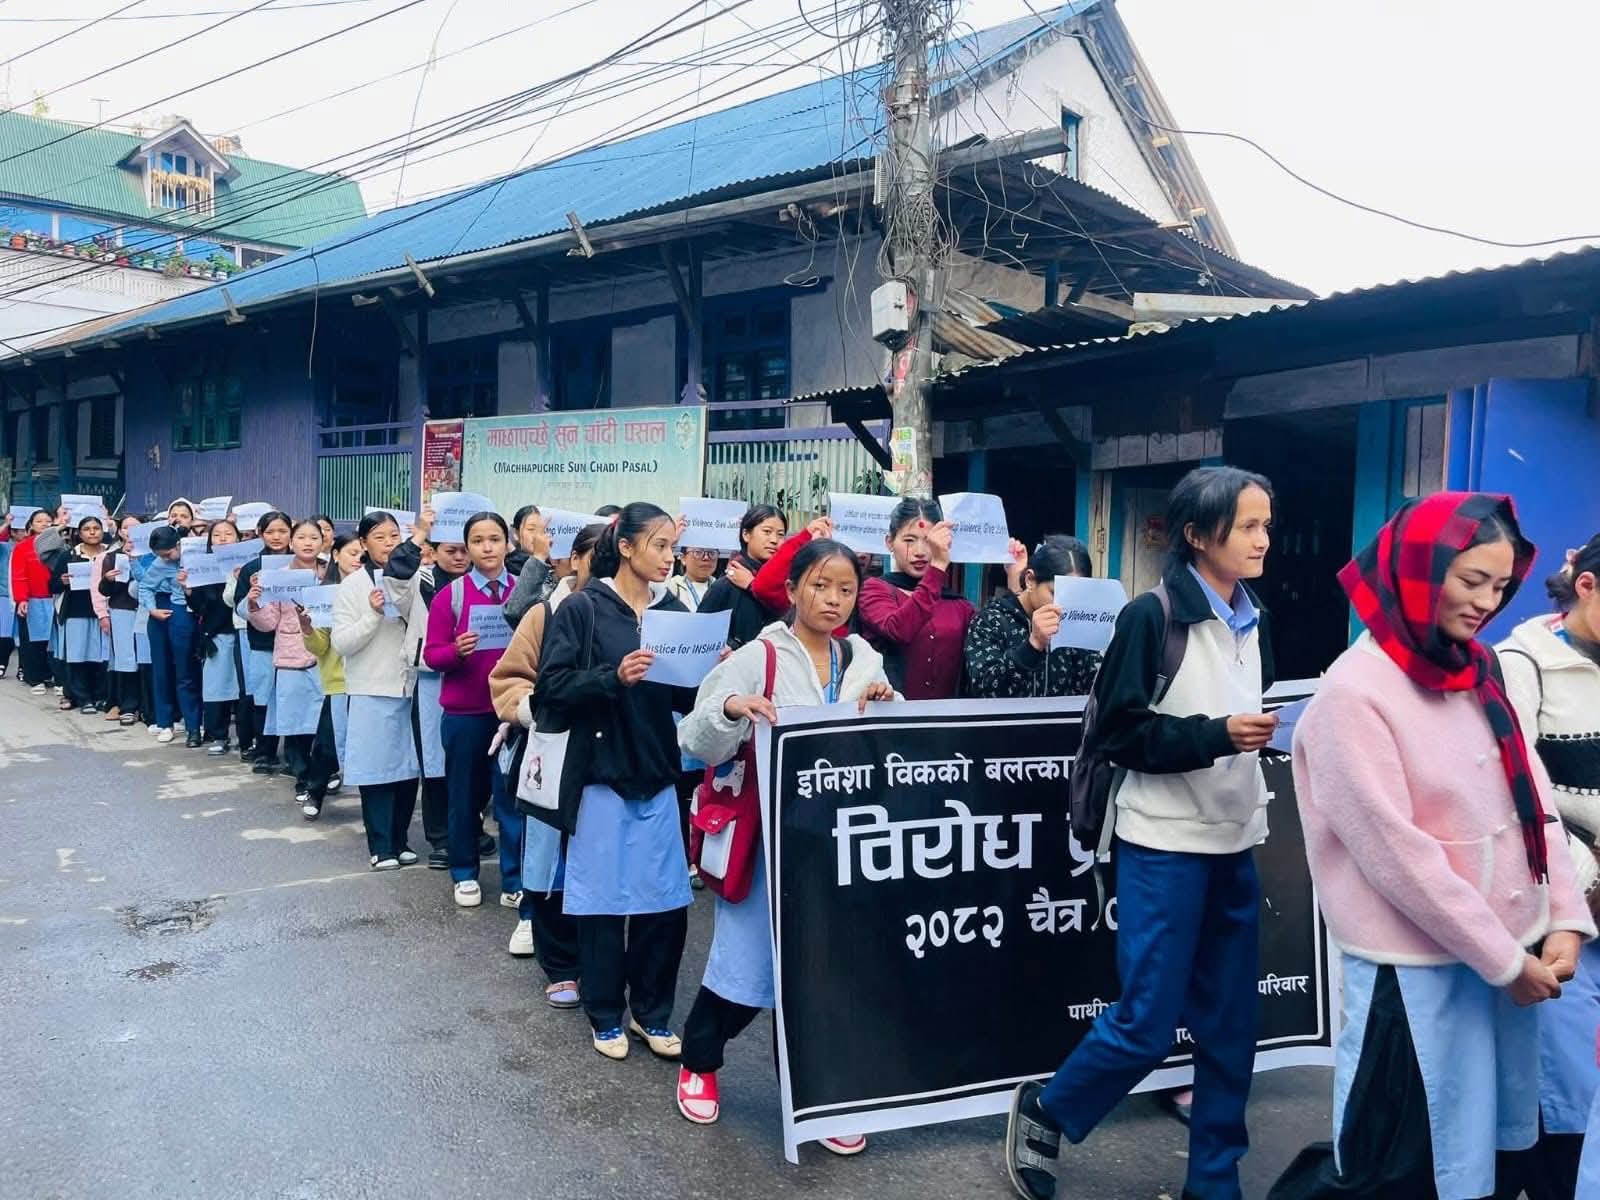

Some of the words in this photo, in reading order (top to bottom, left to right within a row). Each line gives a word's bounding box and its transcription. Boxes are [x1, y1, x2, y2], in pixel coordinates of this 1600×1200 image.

[1099, 611, 1116, 624] Give
[678, 643, 691, 655] for
[797, 758, 875, 798] इनिशा
[884, 752, 974, 787] विकको
[984, 756, 1075, 784] बलत्का
[831, 799, 1042, 887] विरोध
[905, 905, 1004, 959] २०८२
[1025, 886, 1088, 935] चैत्र
[1257, 972, 1309, 997] परिवार
[1067, 998, 1119, 1021] पाथी
